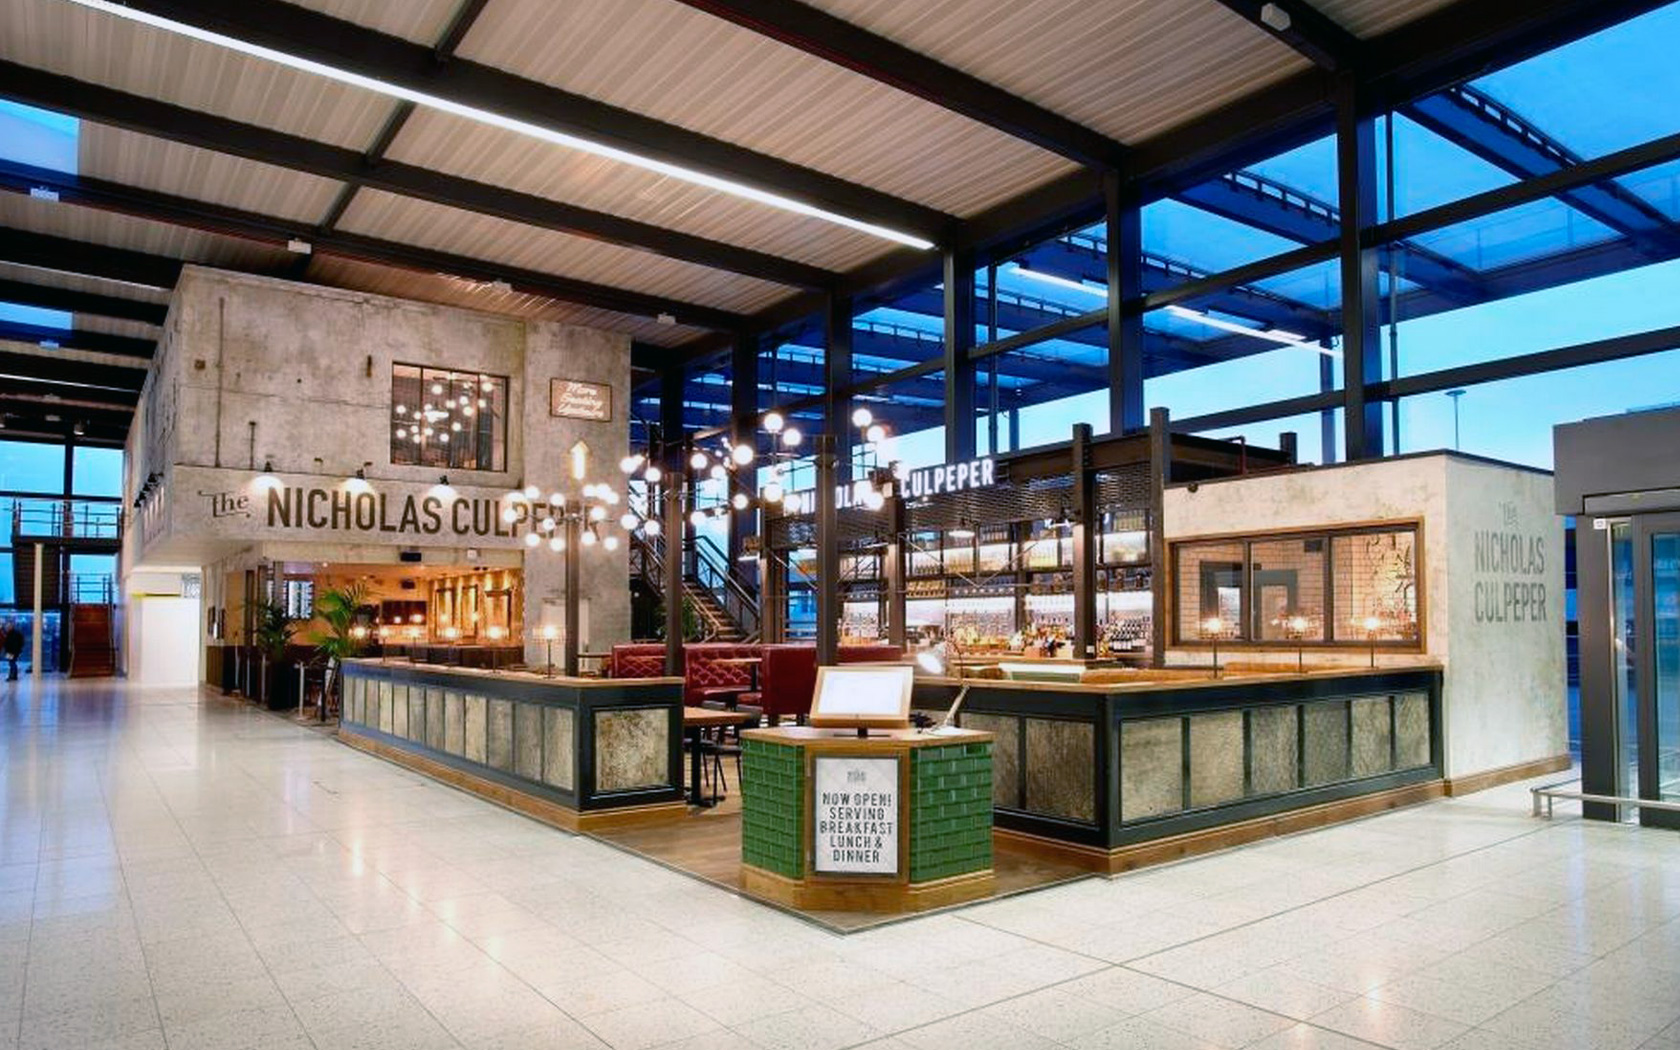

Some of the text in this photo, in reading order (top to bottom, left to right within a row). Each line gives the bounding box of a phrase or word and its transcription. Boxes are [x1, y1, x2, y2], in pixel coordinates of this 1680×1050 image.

[901, 459, 995, 498] CULPEPER
[198, 486, 601, 542] the NICHOLAS CULPEPR
[1475, 530, 1545, 576] NICHOLAS
[1475, 581, 1547, 624] CULPEPER
[822, 792, 892, 807] NOW OPEN!
[829, 807, 885, 820] SERVING
[820, 820, 894, 835] BREAKFAST
[830, 835, 883, 849] LUNCH &
[833, 849, 880, 863] DINNER
